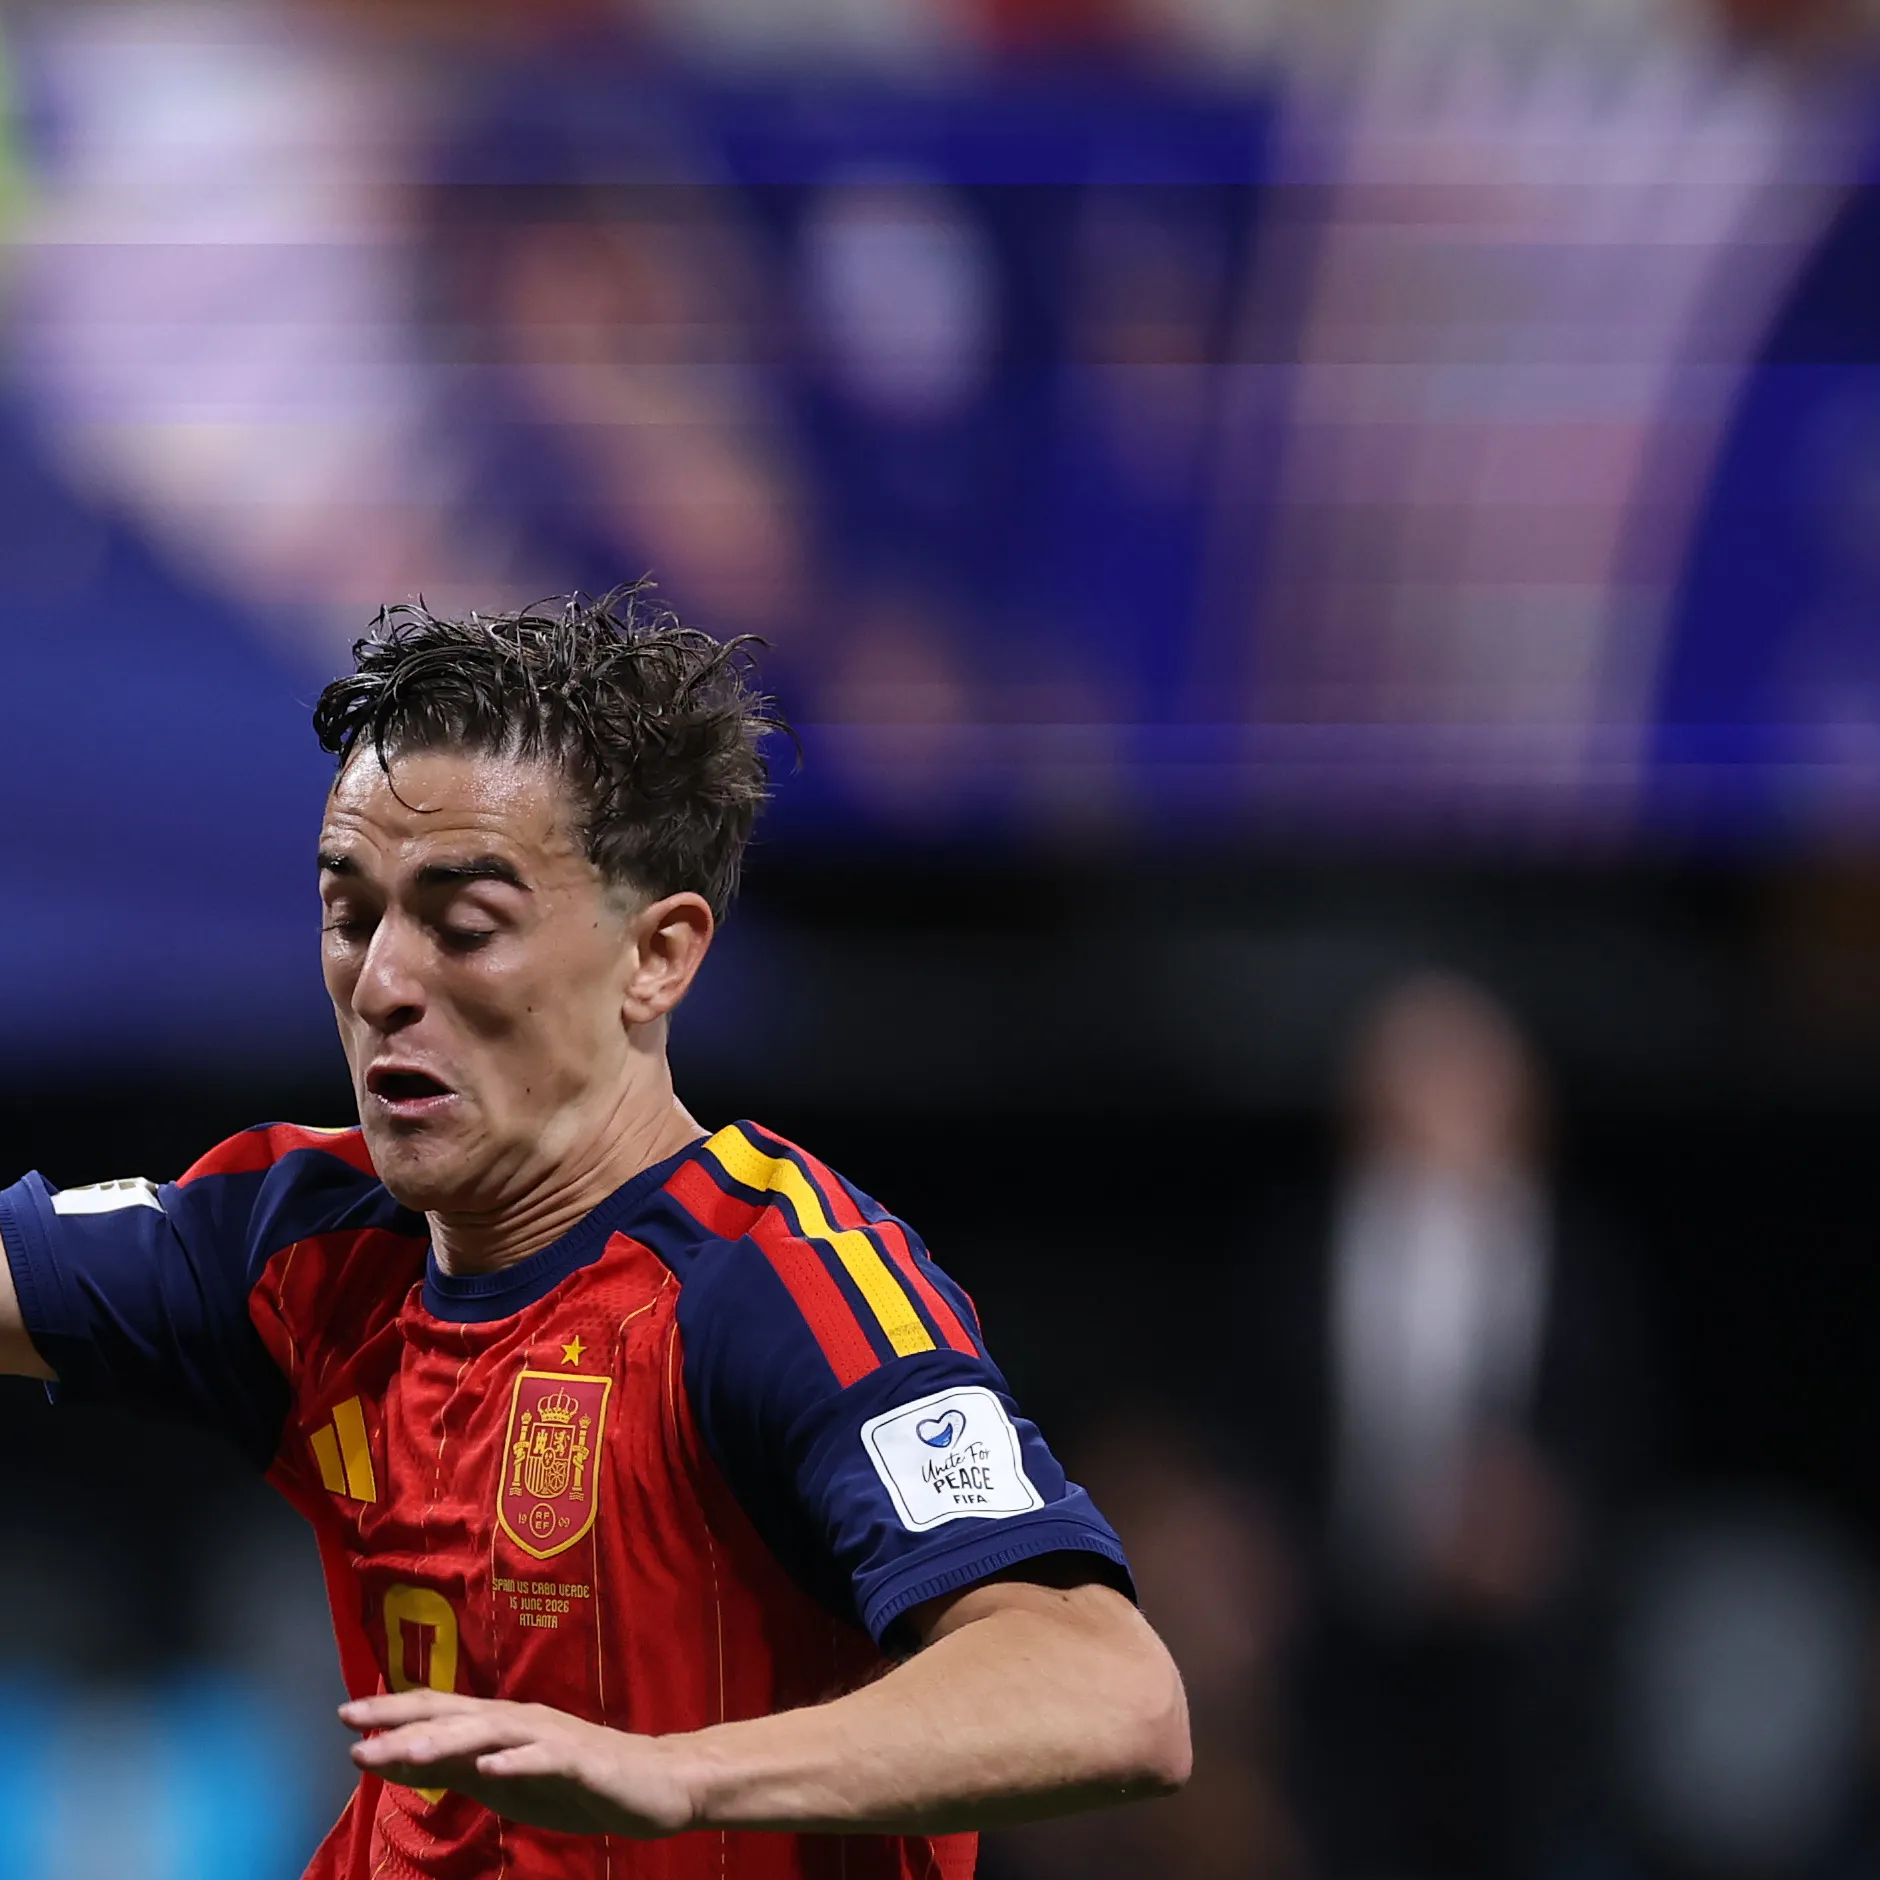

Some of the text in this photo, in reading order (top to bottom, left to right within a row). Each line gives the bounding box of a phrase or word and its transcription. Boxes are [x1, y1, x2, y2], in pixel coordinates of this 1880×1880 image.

[921, 1441, 992, 1484] Unite For
[933, 1466, 995, 1494] PEACE
[953, 1494, 988, 1504] FIFA
[492, 1577, 516, 1592] SPAIN
[559, 1584, 590, 1599] VERDE
[509, 1596, 570, 1613] 15 JUNE 2026
[519, 1613, 558, 1629] ATLANTA
